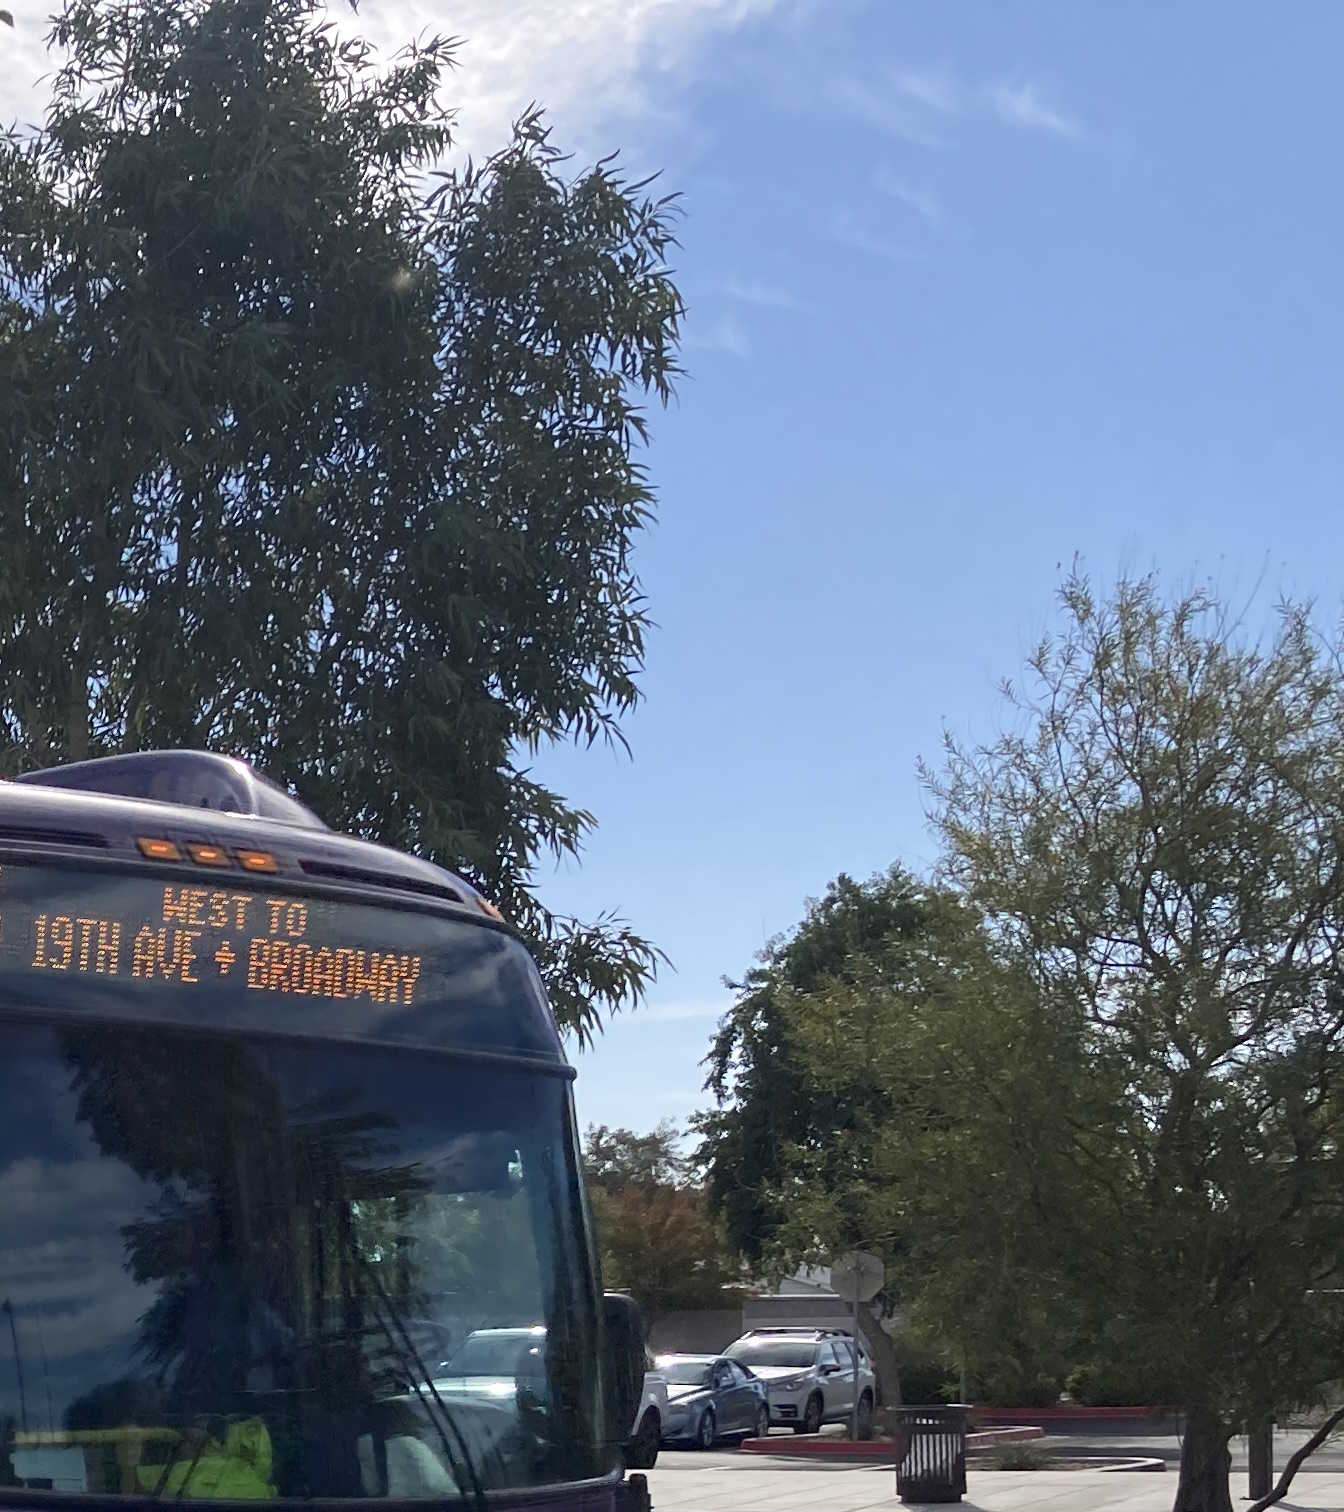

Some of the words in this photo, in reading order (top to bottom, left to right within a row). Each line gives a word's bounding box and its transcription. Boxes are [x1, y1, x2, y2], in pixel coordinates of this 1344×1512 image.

[162, 887, 253, 930] WEST
[266, 899, 308, 937] TO
[31, 914, 120, 975] 19TH
[132, 925, 202, 983] AVE
[214, 940, 236, 974] +
[247, 937, 420, 1005] BROADWAY
